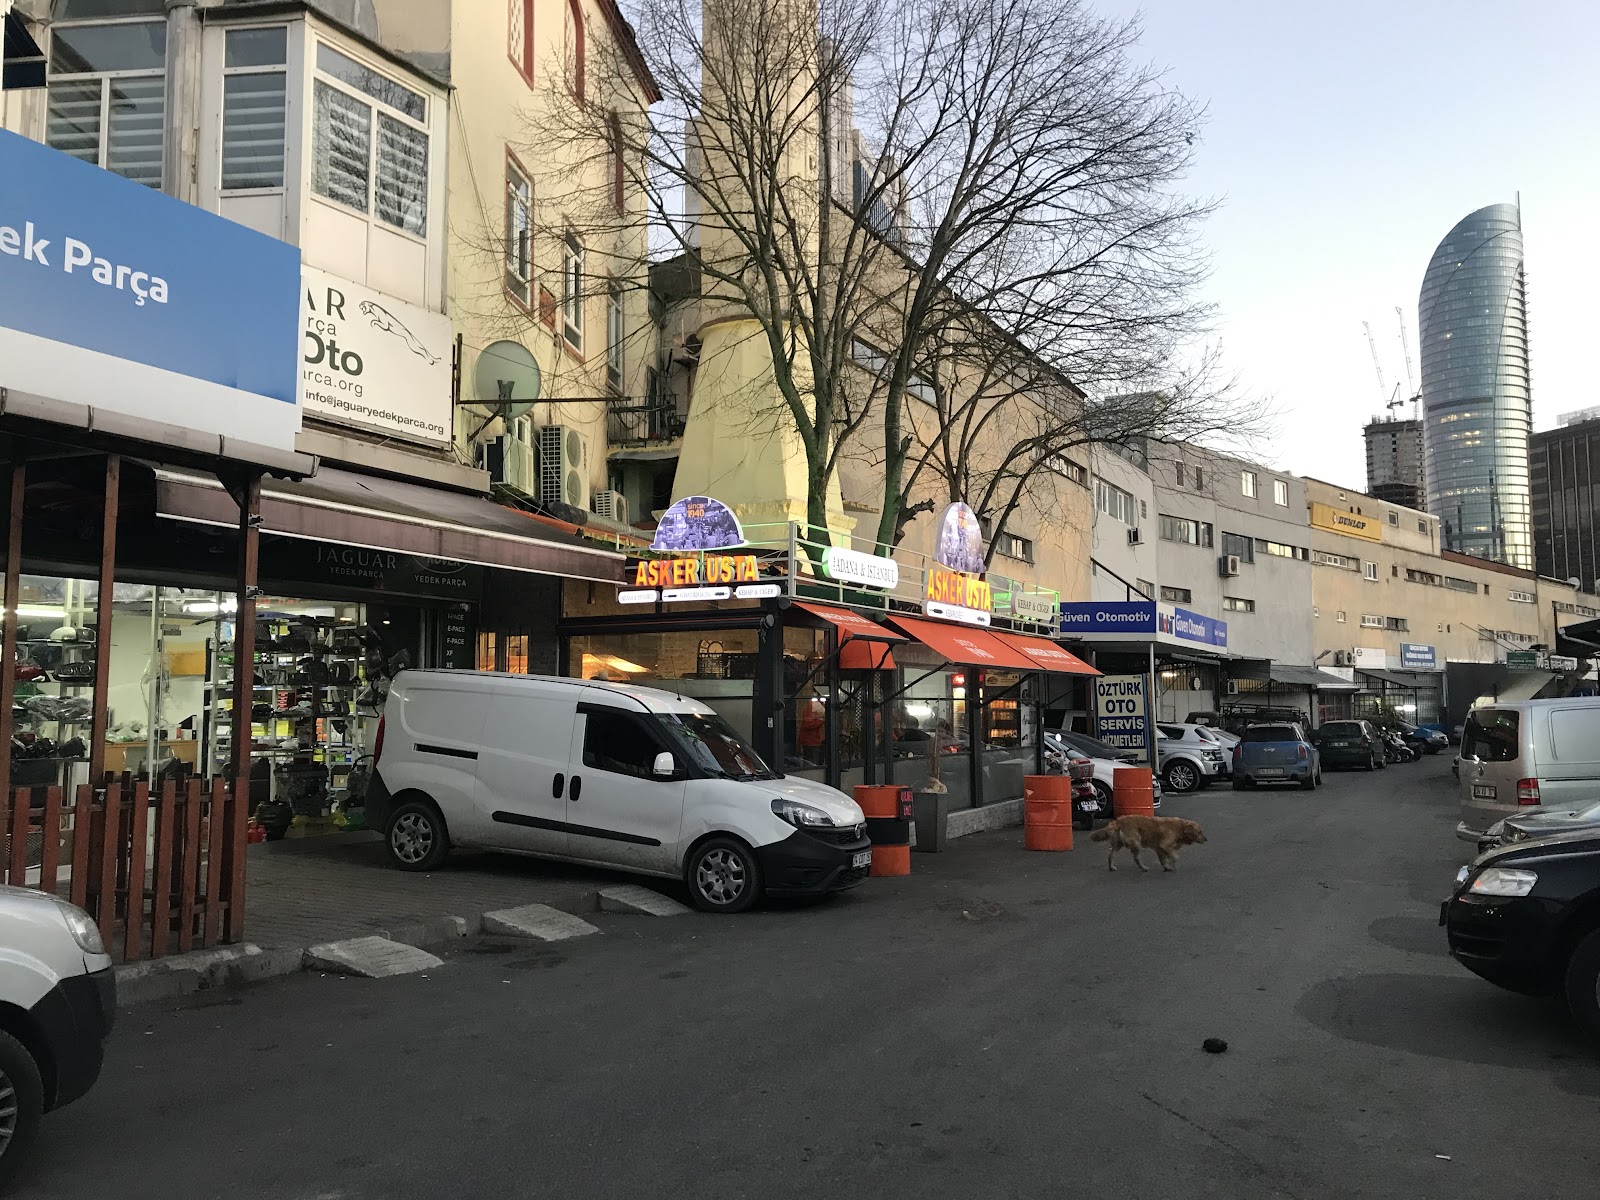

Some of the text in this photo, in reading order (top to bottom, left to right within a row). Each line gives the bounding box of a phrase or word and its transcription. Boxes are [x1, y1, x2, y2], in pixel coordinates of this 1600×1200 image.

[0, 221, 168, 306] ek Parça
[304, 331, 364, 376] Oto
[305, 389, 444, 435] info@jaguaryedekparca.org
[687, 509, 705, 518] 1940
[1338, 516, 1367, 530] DUNLOP
[316, 546, 397, 569] JAGUAR
[330, 566, 384, 579] YEDEK PARÇA
[635, 555, 759, 587] ASKER USTA
[414, 574, 467, 588] YEDEK PARÇA
[927, 568, 991, 611] ASKER USTA
[1058, 611, 1151, 622] Güven Otomotiv
[447, 625, 466, 633] E-PACE
[1176, 614, 1189, 634] Güven
[1189, 618, 1206, 637] Otomotiv
[446, 637, 465, 645] F-PACE
[1098, 680, 1142, 697] ÖZTÜRK
[1105, 698, 1136, 714] OTO
[1100, 717, 1145, 731] SERVİS
